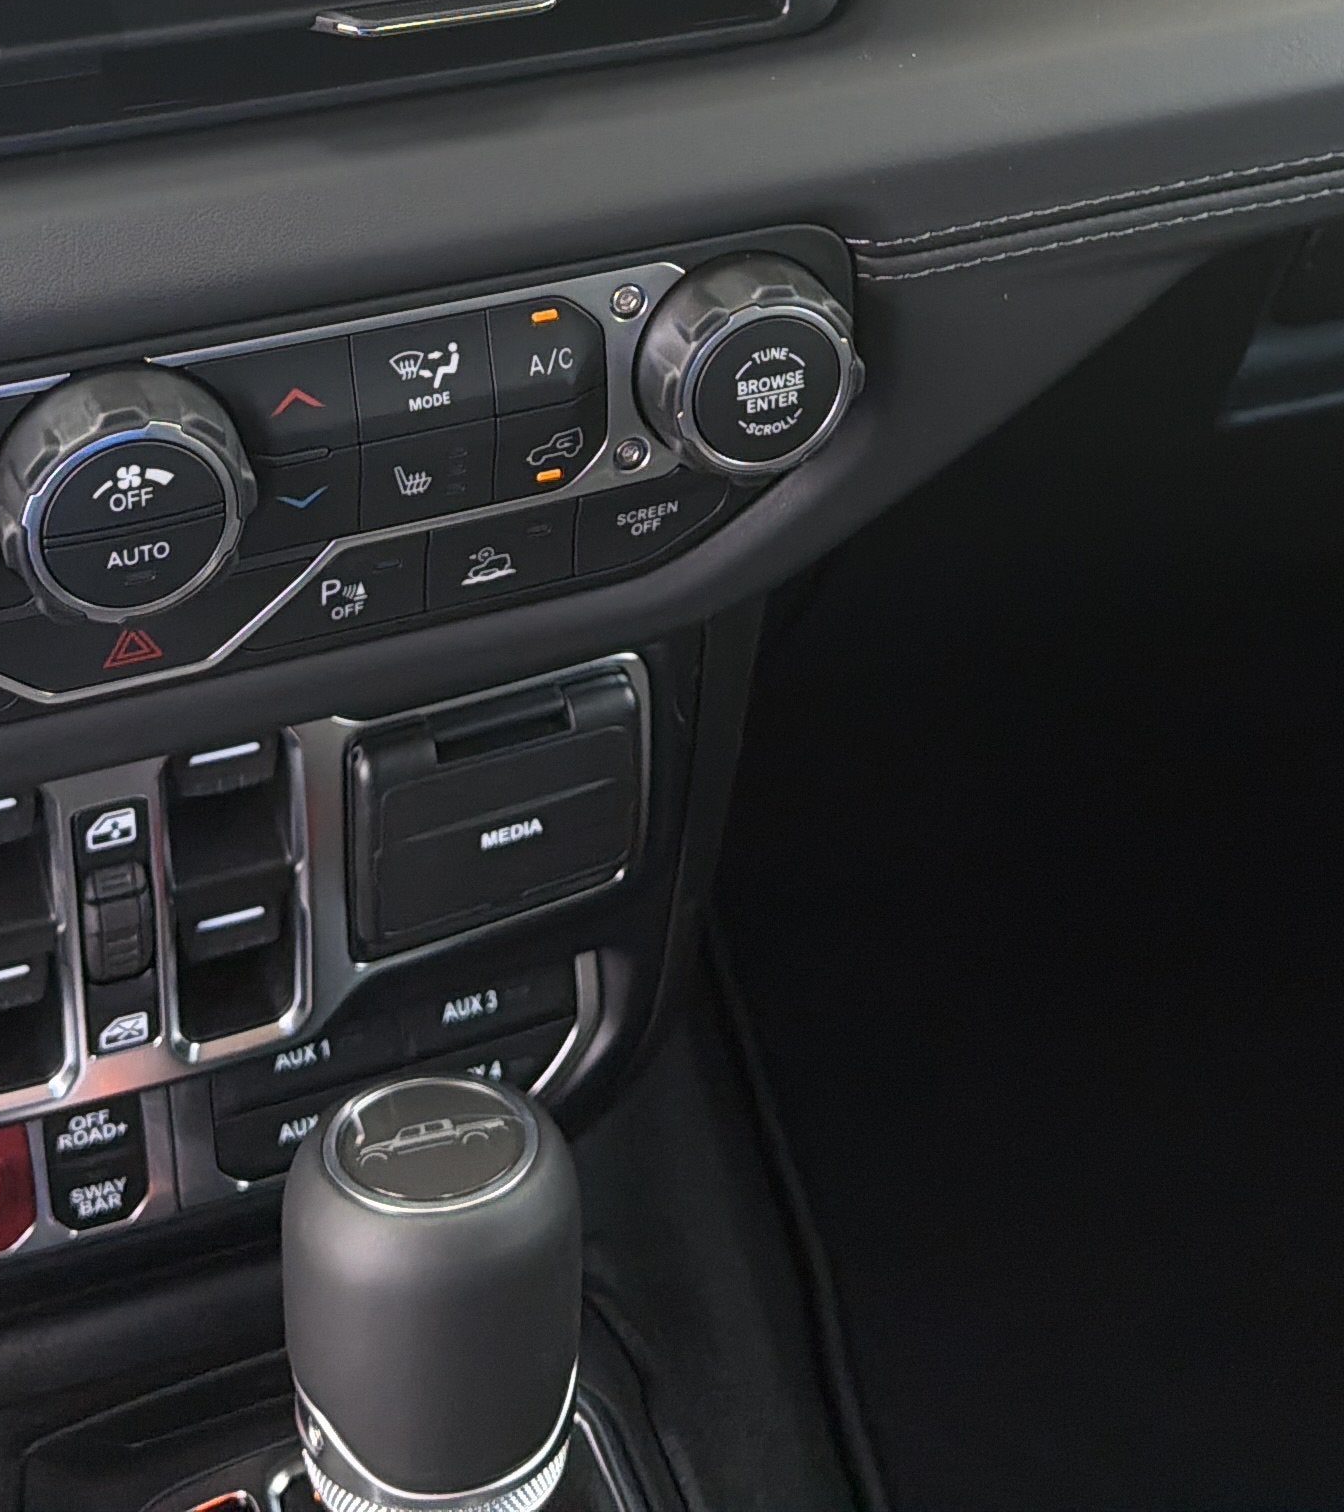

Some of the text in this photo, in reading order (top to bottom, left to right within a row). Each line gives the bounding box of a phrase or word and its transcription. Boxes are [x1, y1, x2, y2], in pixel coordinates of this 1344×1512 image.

[529, 347, 574, 377] A/C
[752, 346, 790, 365] TUNE
[736, 369, 805, 396] BROWSE
[408, 390, 452, 413] MODE
[746, 390, 799, 414] ENTER
[745, 414, 798, 437] SCROLL
[108, 487, 154, 513] OFF
[616, 500, 680, 526] SCREEN
[629, 516, 662, 537] OFF
[106, 541, 171, 570] AUTO
[330, 598, 368, 621] OFF
[480, 818, 543, 850] MEDIA
[443, 988, 499, 1024] AUX 3
[274, 1037, 332, 1073] AUX 1
[68, 1108, 111, 1131] OFF
[57, 1120, 129, 1152] ROAD+
[69, 1176, 128, 1205] SWAY
[77, 1192, 123, 1220] BAR
